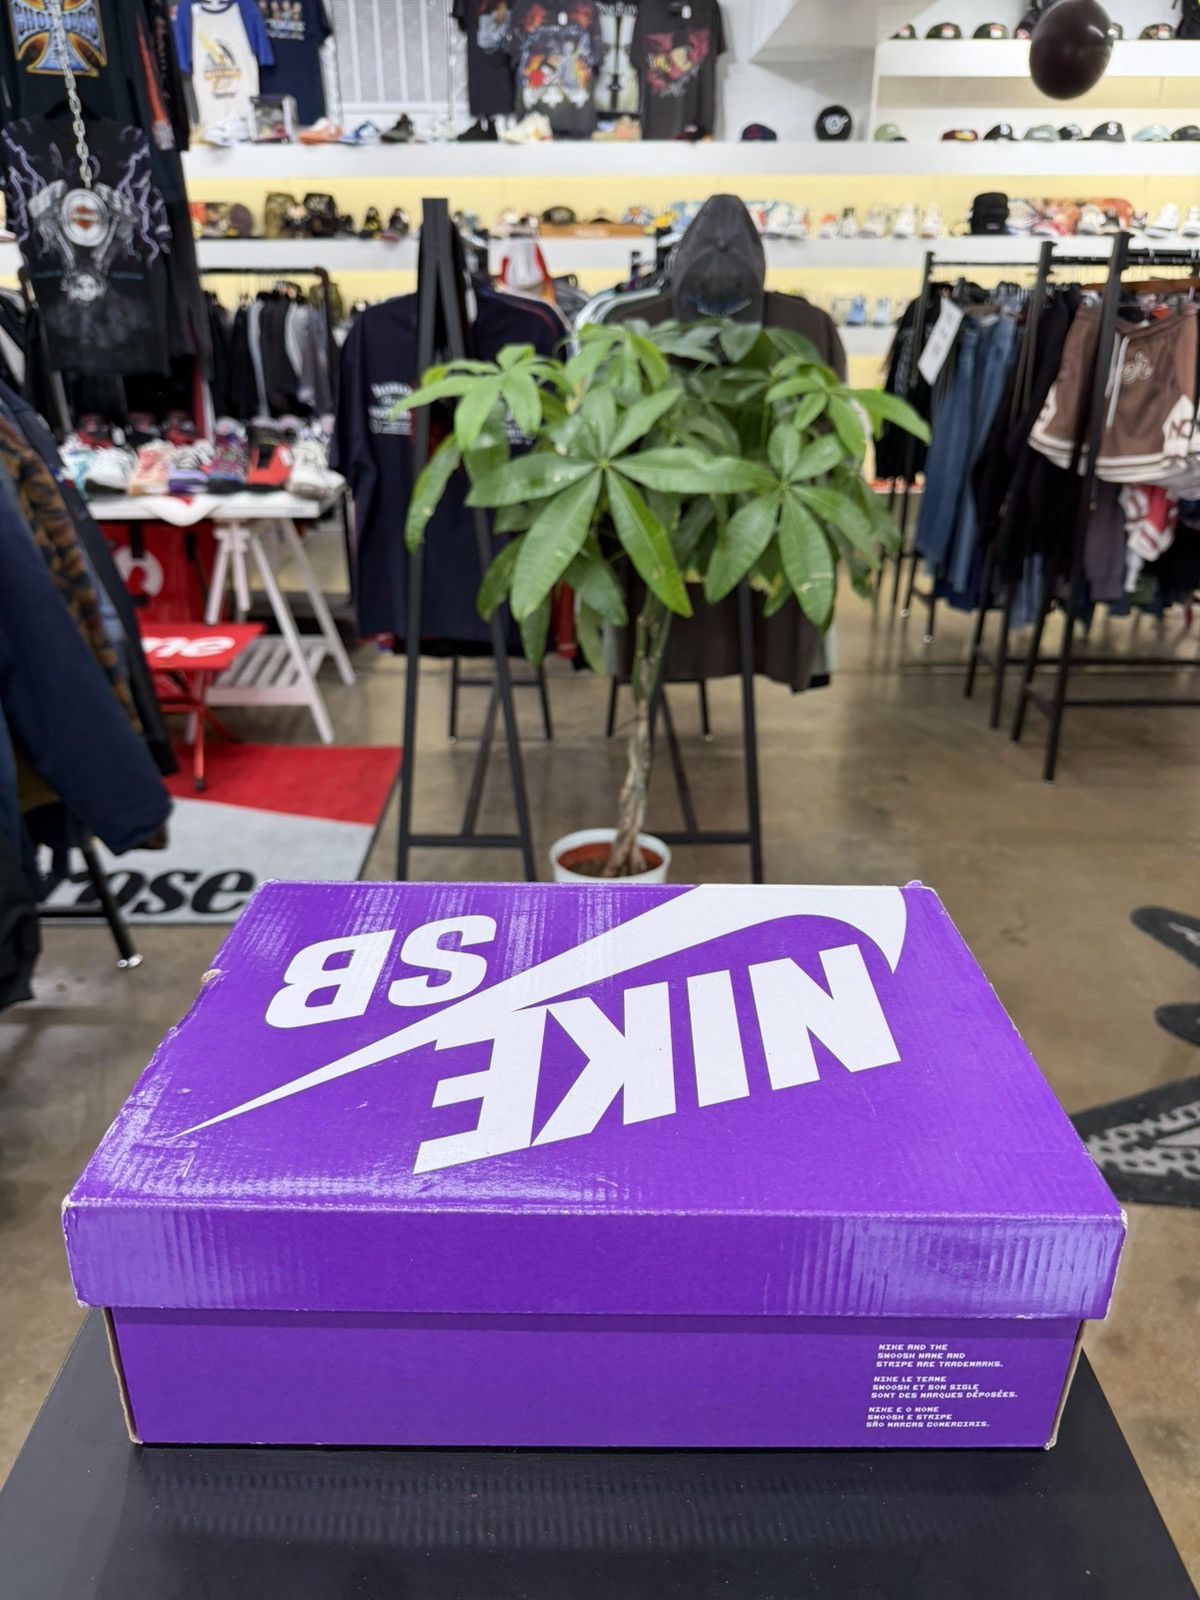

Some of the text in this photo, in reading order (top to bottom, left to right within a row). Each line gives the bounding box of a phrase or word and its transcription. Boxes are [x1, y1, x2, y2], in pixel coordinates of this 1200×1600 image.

[264, 914, 497, 1029] SB
[413, 942, 902, 1175] NIKE
[877, 1352, 966, 1360] SWOOSH NAME AND
[876, 1360, 1004, 1368] STRIPE ARE TRADEMARKS.
[966, 1389, 1018, 1399] DÉPOSÉES.
